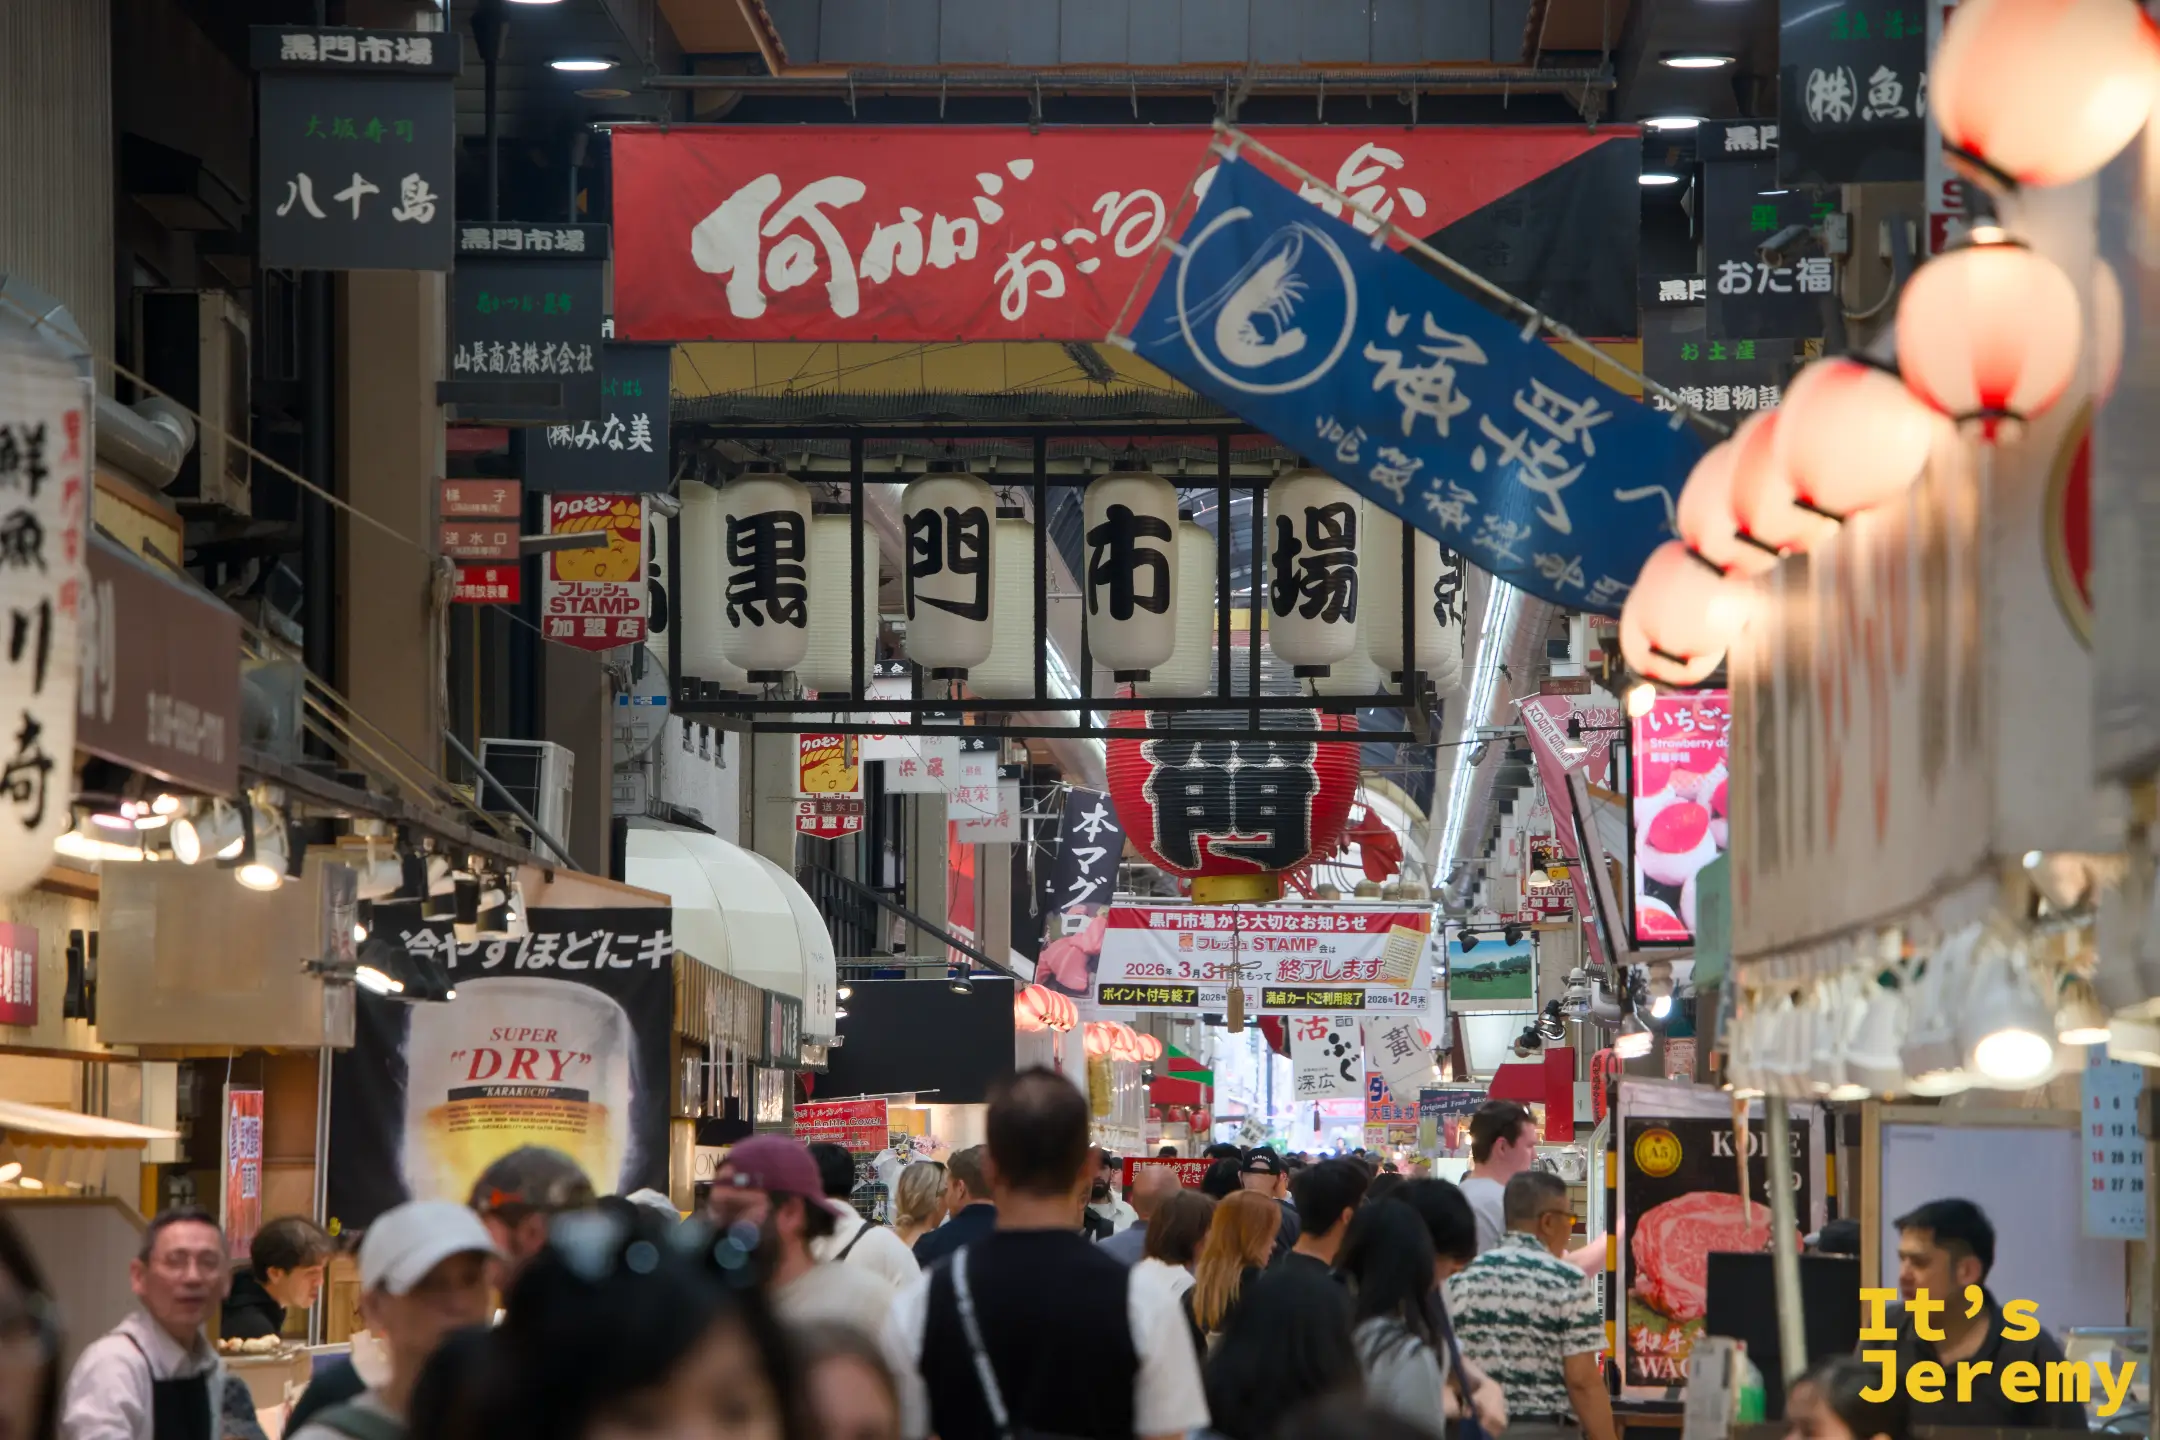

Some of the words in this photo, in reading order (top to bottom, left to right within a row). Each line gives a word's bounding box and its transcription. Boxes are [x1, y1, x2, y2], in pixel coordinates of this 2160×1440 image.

[280, 33, 434, 65] 黒門市場
[275, 171, 439, 224] 八十島
[461, 228, 585, 252] 黒門市場
[1717, 256, 1832, 295] おた福
[454, 341, 594, 375] 山長商店株式会社
[1680, 339, 1756, 361] お土産
[547, 412, 653, 453] (株)みな美
[553, 496, 612, 519] クロモン
[445, 531, 508, 546] 送水口
[558, 581, 630, 598] フレッシュ
[550, 596, 641, 616] STAMP
[550, 617, 641, 639] 加盟店
[1650, 738, 1714, 750] Strawberry
[821, 799, 859, 812] 送水口
[800, 816, 859, 830] 加盟店
[1060, 802, 1119, 935] 本マグロ
[1149, 911, 1368, 931] 黒門市場から大切なお知らせ
[1253, 936, 1319, 953] STAMP
[1102, 987, 1197, 1004] ポイント付与終了
[489, 1027, 559, 1043] SUPER
[1420, 1101, 1448, 1112] Original
[814, 1117, 847, 1129] Bottle
[849, 1116, 882, 1127] Cover
